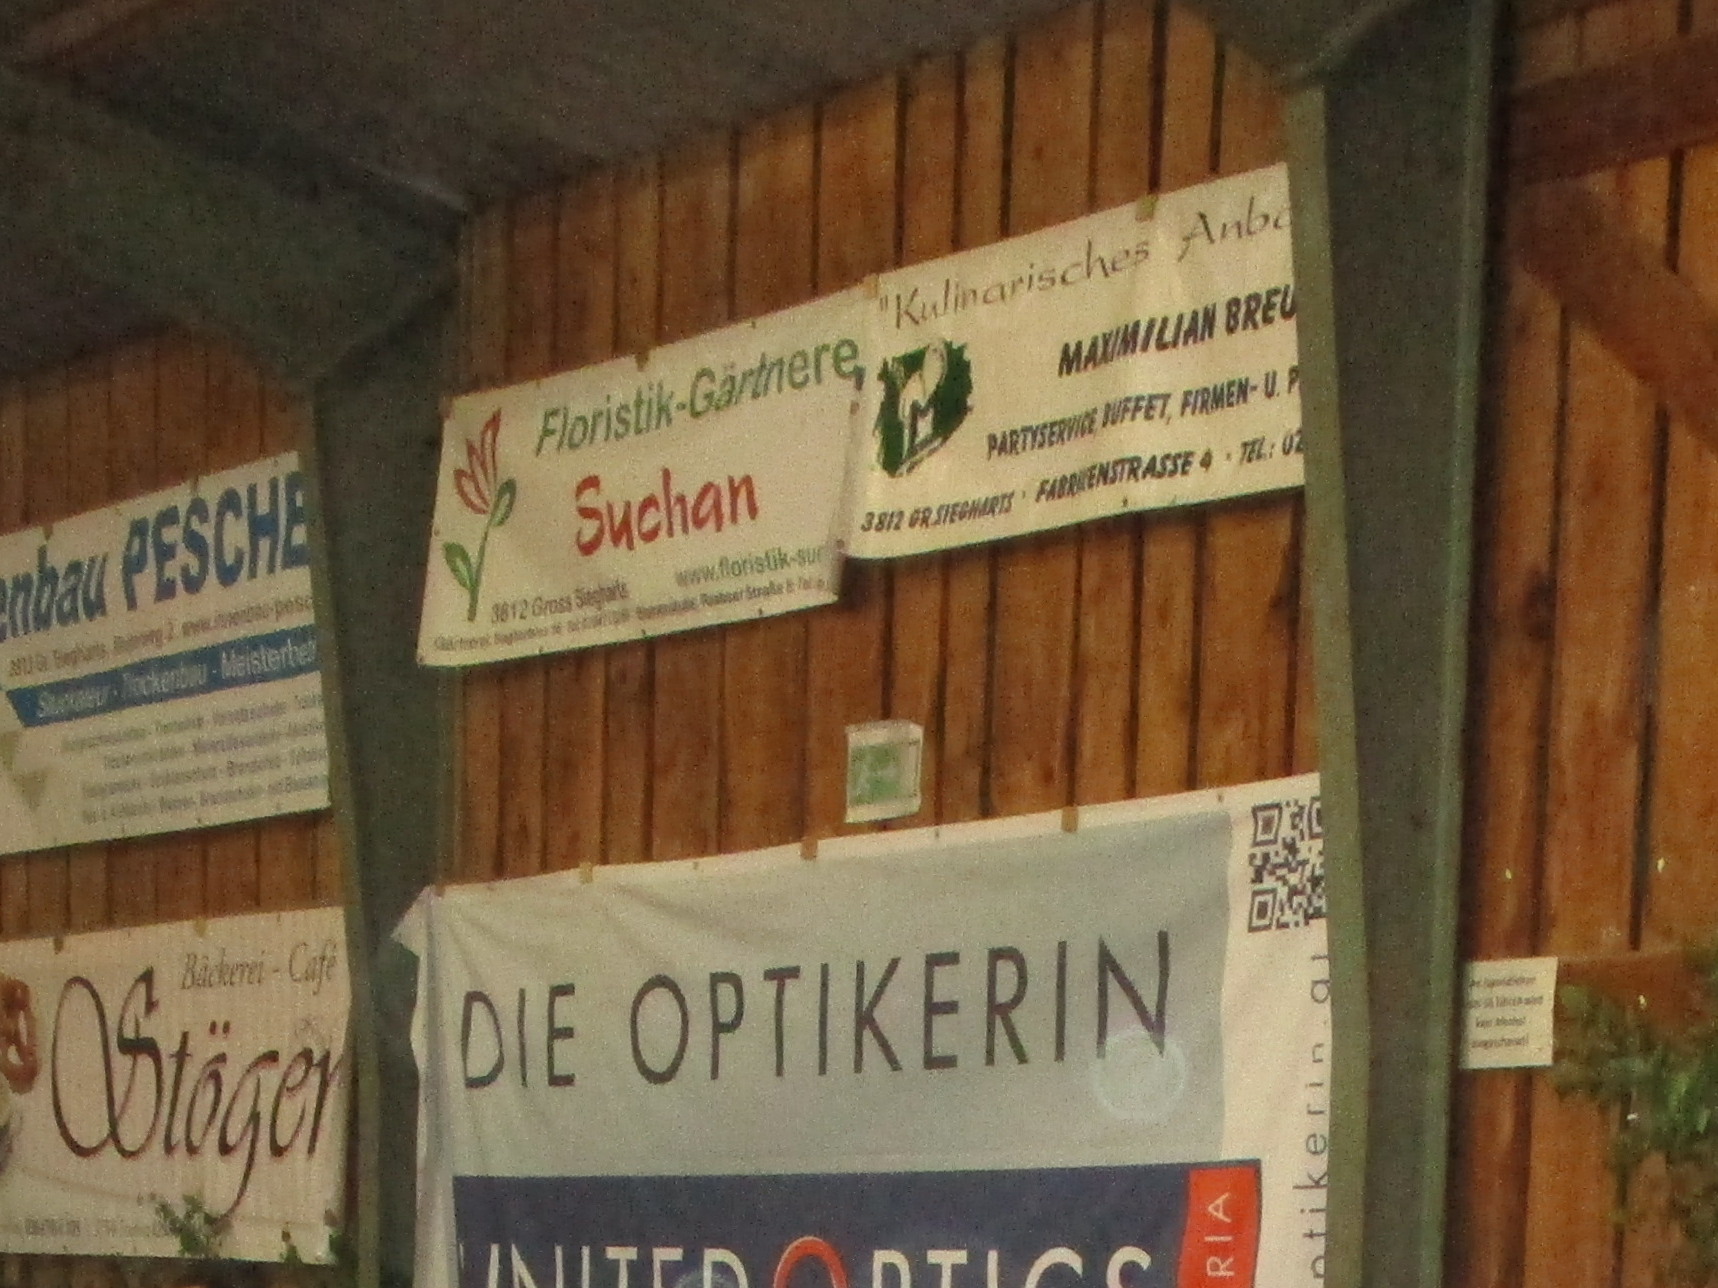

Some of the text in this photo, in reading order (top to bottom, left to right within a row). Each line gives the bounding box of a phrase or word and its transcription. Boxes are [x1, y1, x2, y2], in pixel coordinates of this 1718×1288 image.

[1057, 302, 1218, 377] MAXIMILIAN
[1180, 377, 1258, 418] FIRMEN-
[122, 470, 309, 612] PESCHE
[575, 467, 759, 556] Suchan
[862, 511, 905, 533] 3812
[179, 948, 267, 991] Bäckerei
[461, 929, 1172, 1089] DIE OPTIKERIN
[51, 966, 345, 1226] Stöger
